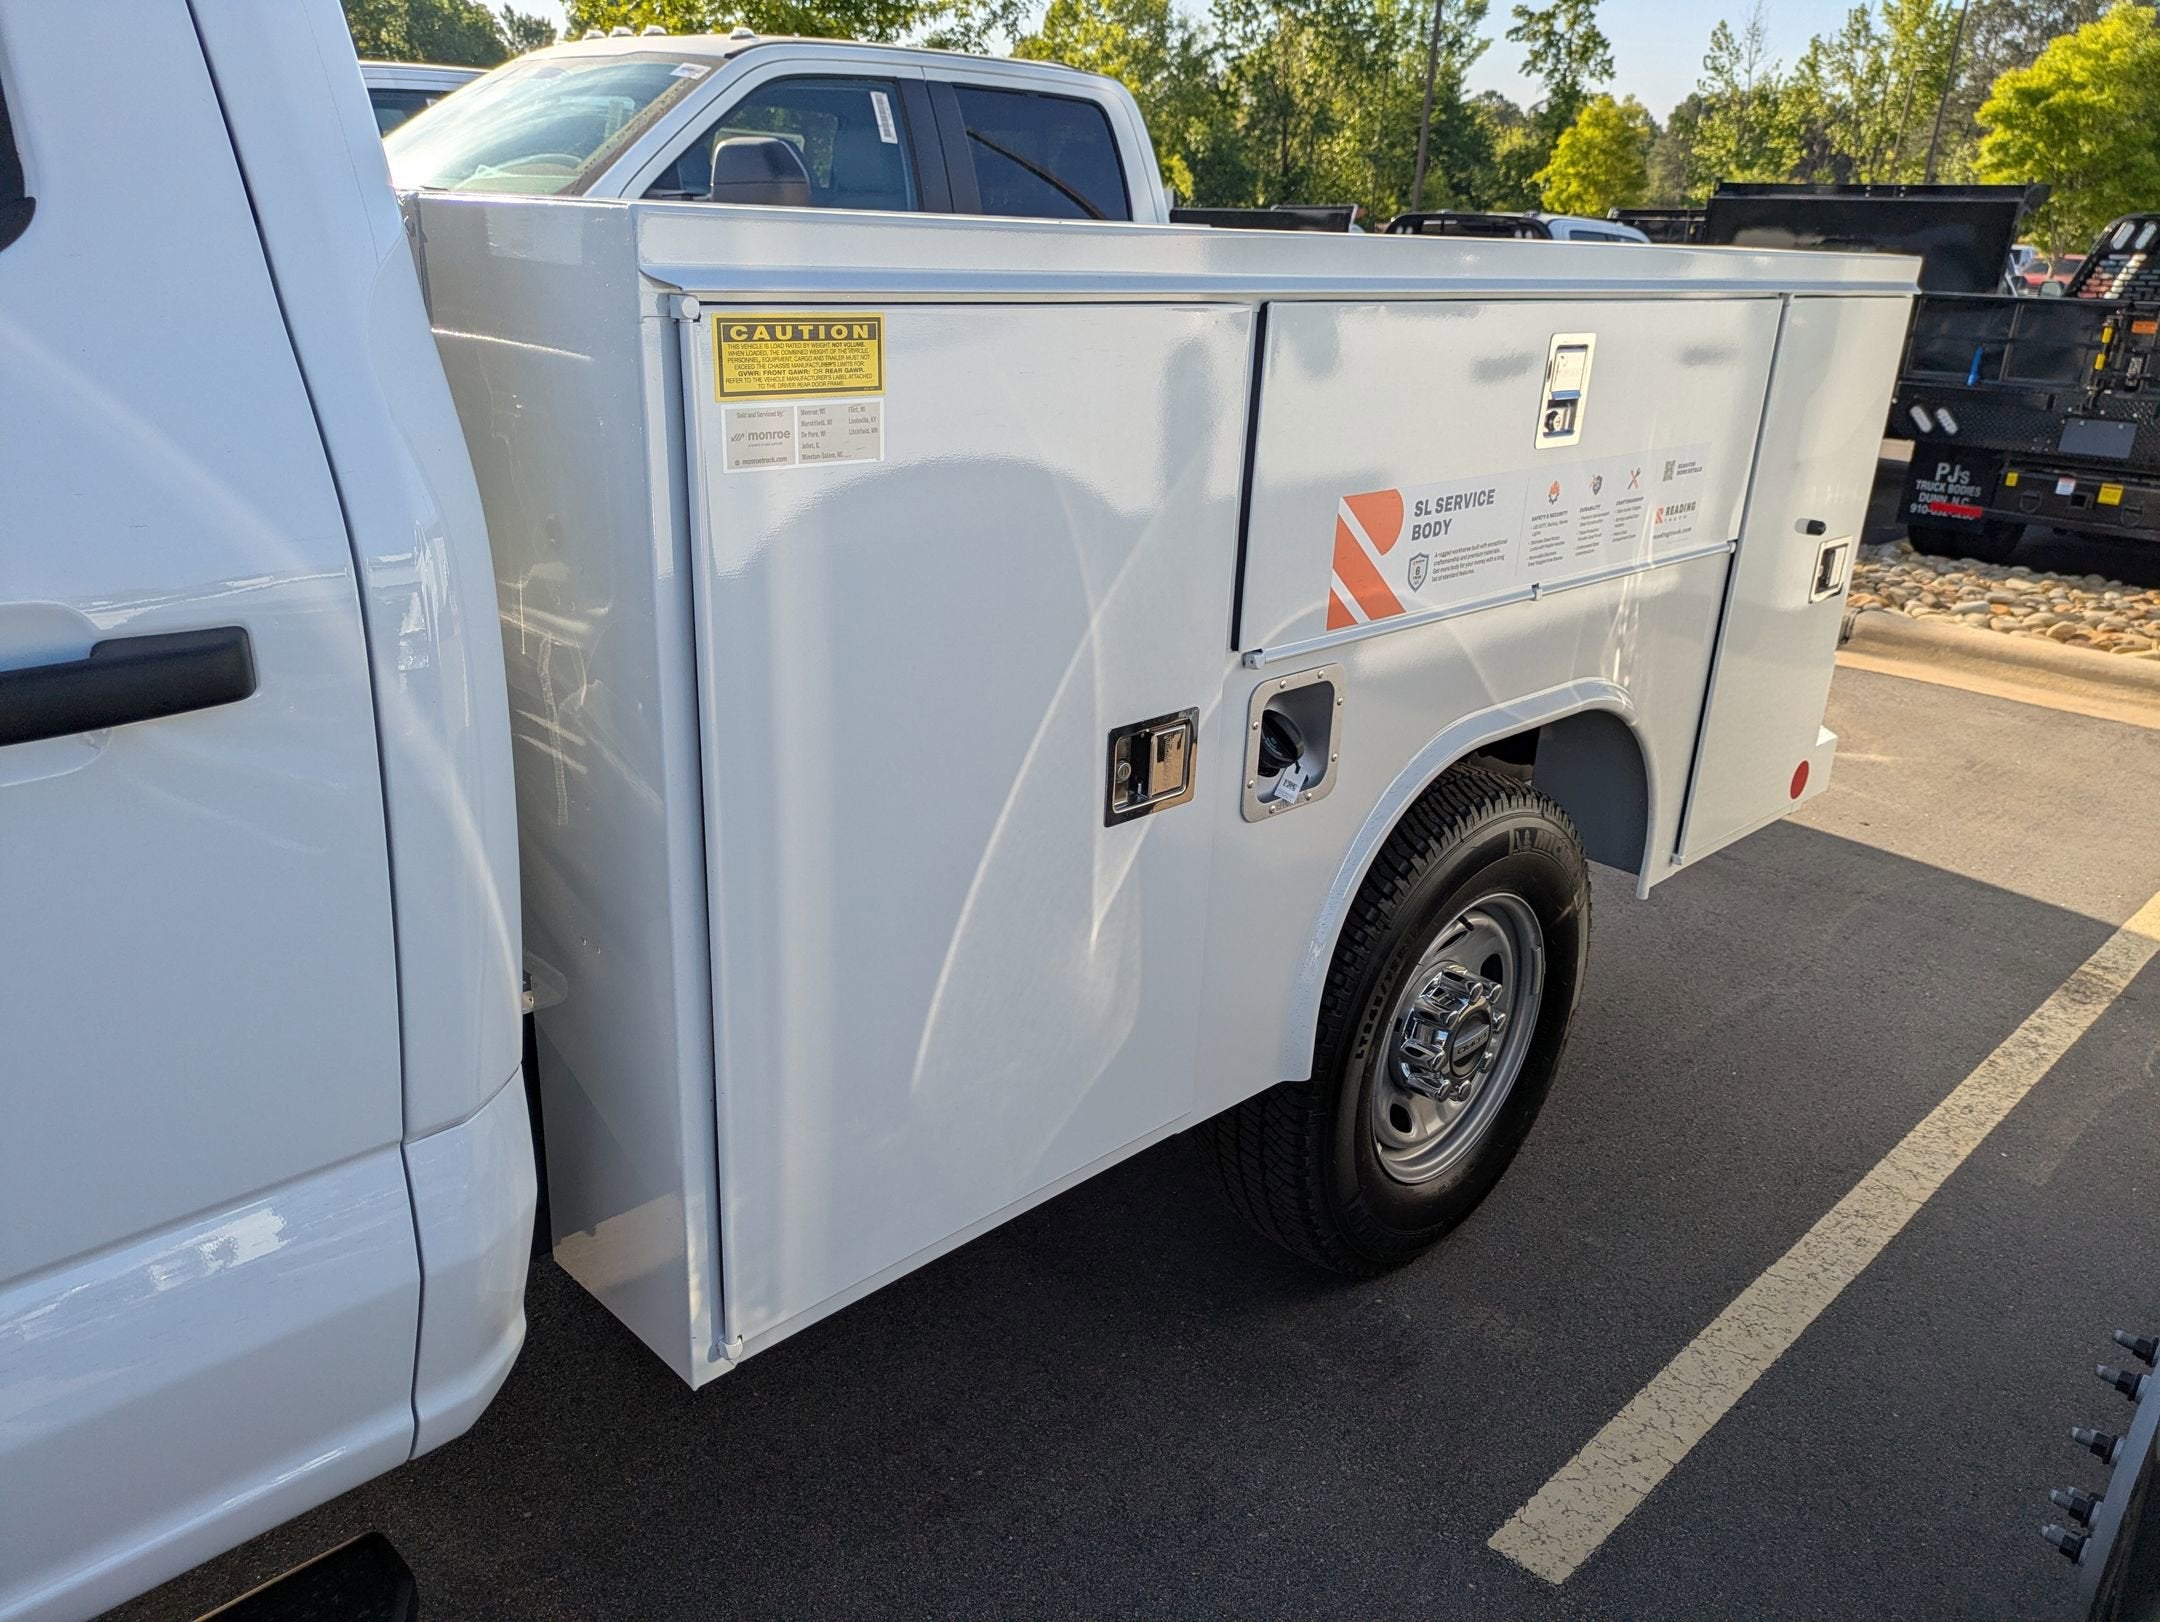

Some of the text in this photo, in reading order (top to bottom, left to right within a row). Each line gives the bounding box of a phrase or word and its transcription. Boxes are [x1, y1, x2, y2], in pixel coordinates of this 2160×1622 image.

[730, 325, 869, 340] CAUTION
[748, 430, 791, 440] monroe
[1915, 479, 1982, 498] TRUCK BODIES
[1414, 489, 1496, 517] SL SERVICE
[1665, 501, 1696, 516] READING
[1411, 519, 1453, 541] BODY
[1415, 566, 1421, 576] 6
